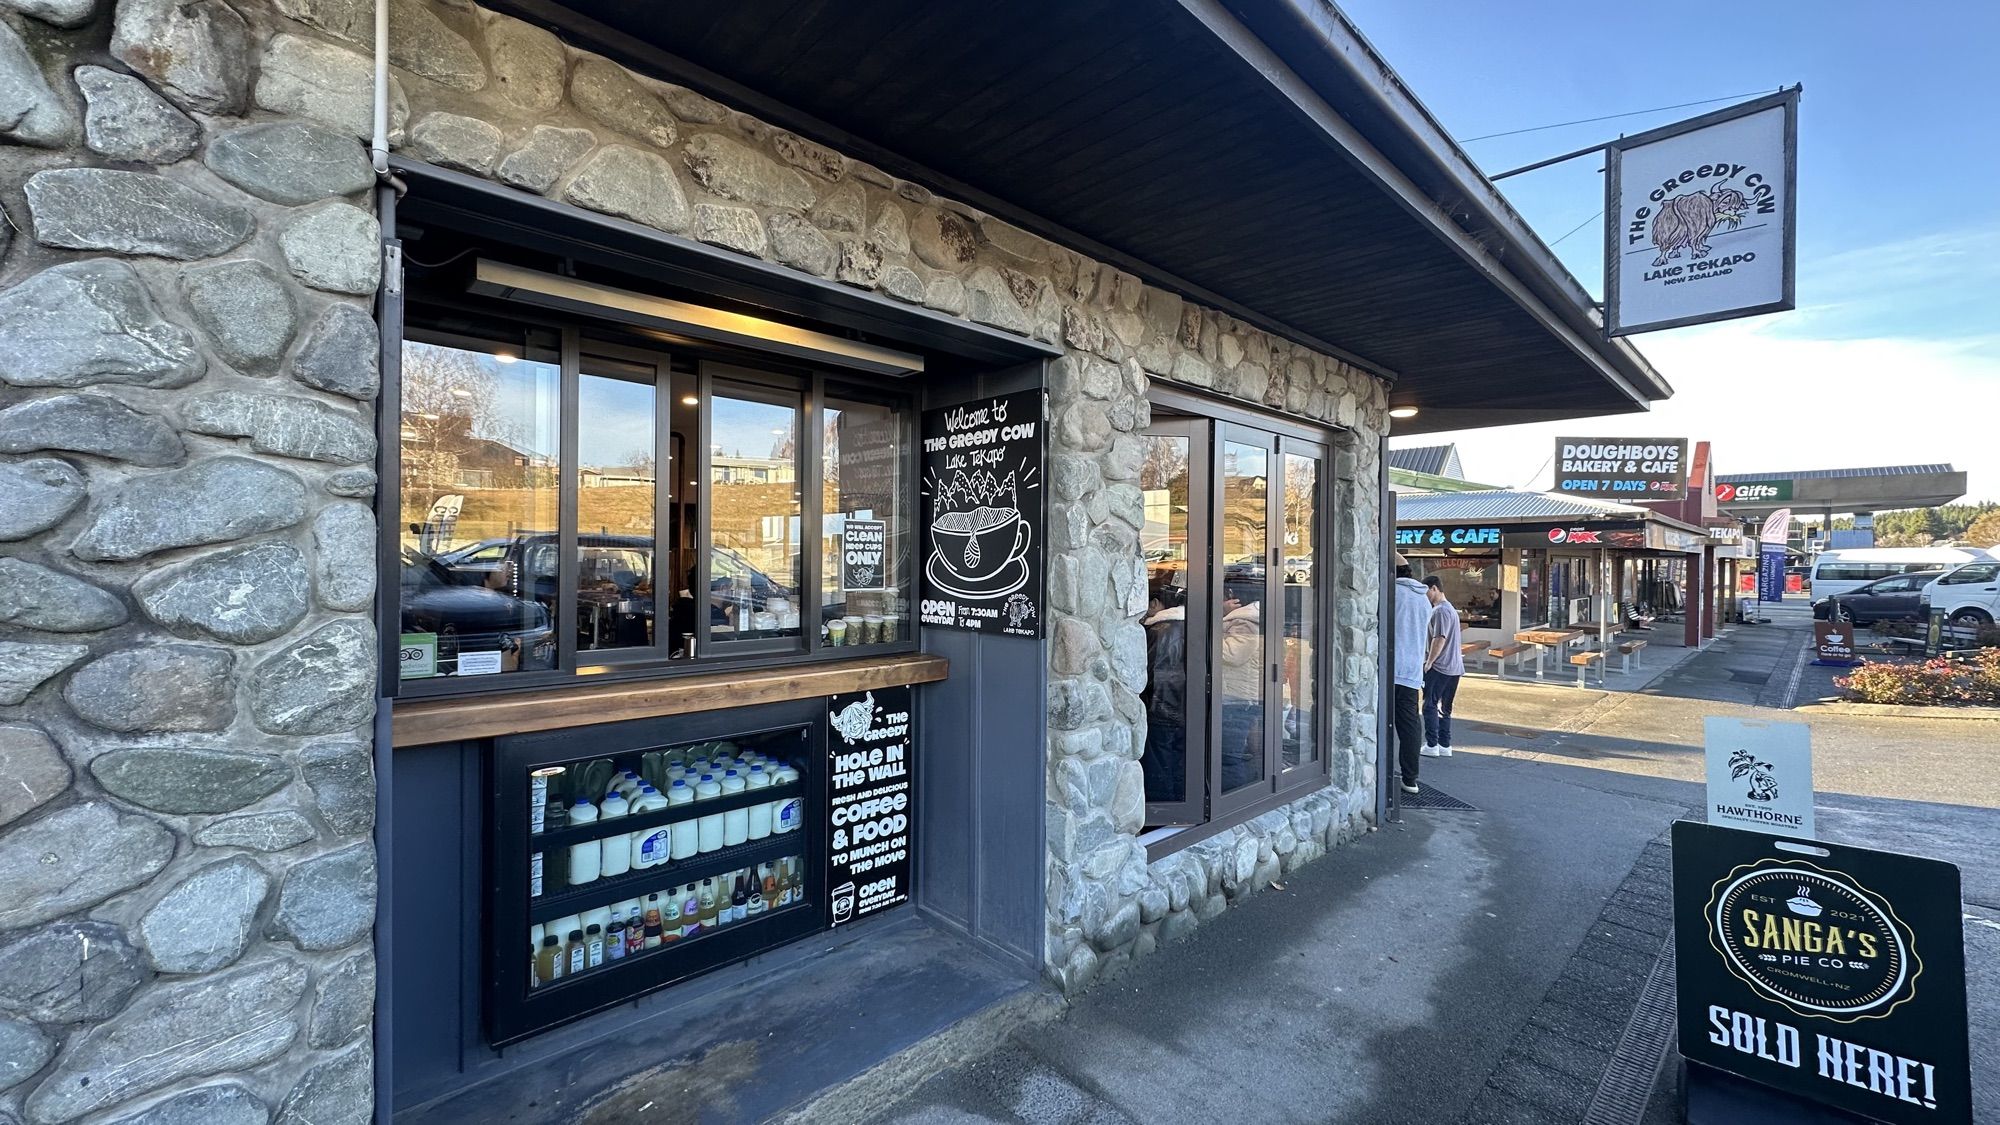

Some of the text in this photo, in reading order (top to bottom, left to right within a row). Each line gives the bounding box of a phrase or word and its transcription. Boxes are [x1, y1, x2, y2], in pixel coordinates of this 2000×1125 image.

[1744, 173, 1775, 215] COW
[944, 400, 1008, 432] Welcome to
[1001, 422, 1035, 442] COW
[1562, 444, 1680, 460] DOUGHBOYS
[1562, 460, 1678, 474] BAKERY & CAFE
[1562, 480, 1646, 491] OPEN 7 DAYS
[1736, 485, 1778, 496] Gifts
[1429, 528, 1446, 544] &
[1450, 528, 1500, 544] CAFE
[1566, 531, 1602, 543] MAX
[846, 551, 882, 565] ONLY
[1761, 554, 1769, 600] STARGAZING
[971, 608, 998, 618] 7:30AM
[1028, 602, 1036, 618] COW
[966, 619, 981, 628] 4PM
[1820, 645, 1850, 653] Coffee
[886, 744, 903, 762] IN
[868, 761, 906, 782] WALL
[857, 790, 872, 800] AND
[1717, 804, 1803, 825] HAWTHORNE
[832, 814, 907, 850] & FOOD
[831, 835, 906, 866] TO MUNCH ON
[1751, 894, 1865, 922] EST 2021
[1743, 908, 1878, 958] SANGA'S
[1782, 954, 1844, 969] PIE CO
[1708, 1004, 1937, 1110] SOLD HERE!
